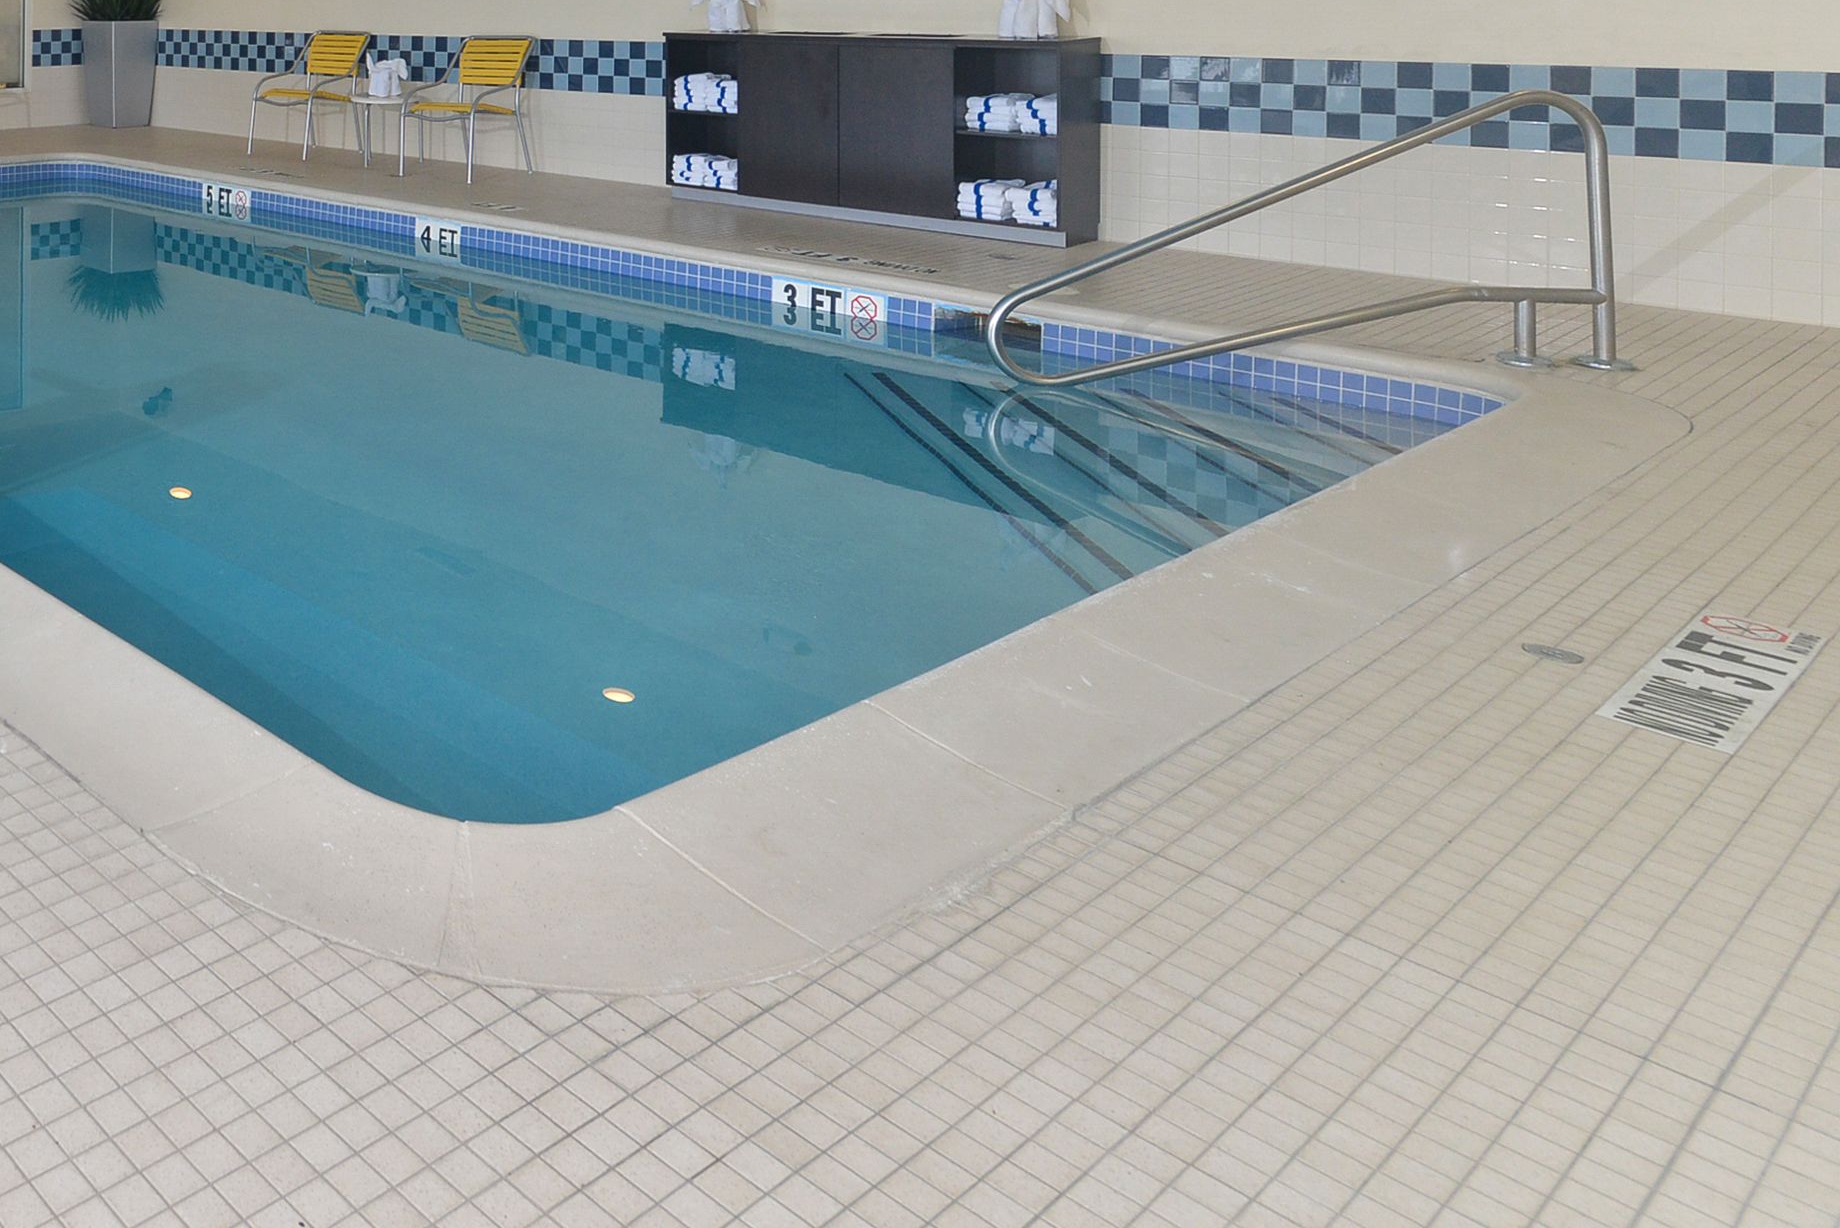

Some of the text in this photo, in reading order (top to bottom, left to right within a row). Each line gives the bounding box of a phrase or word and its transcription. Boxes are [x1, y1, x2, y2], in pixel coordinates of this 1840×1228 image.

[421, 225, 432, 242] 4
[783, 284, 797, 310] 3
[1613, 630, 1798, 747] NO DIVING 3 FT
